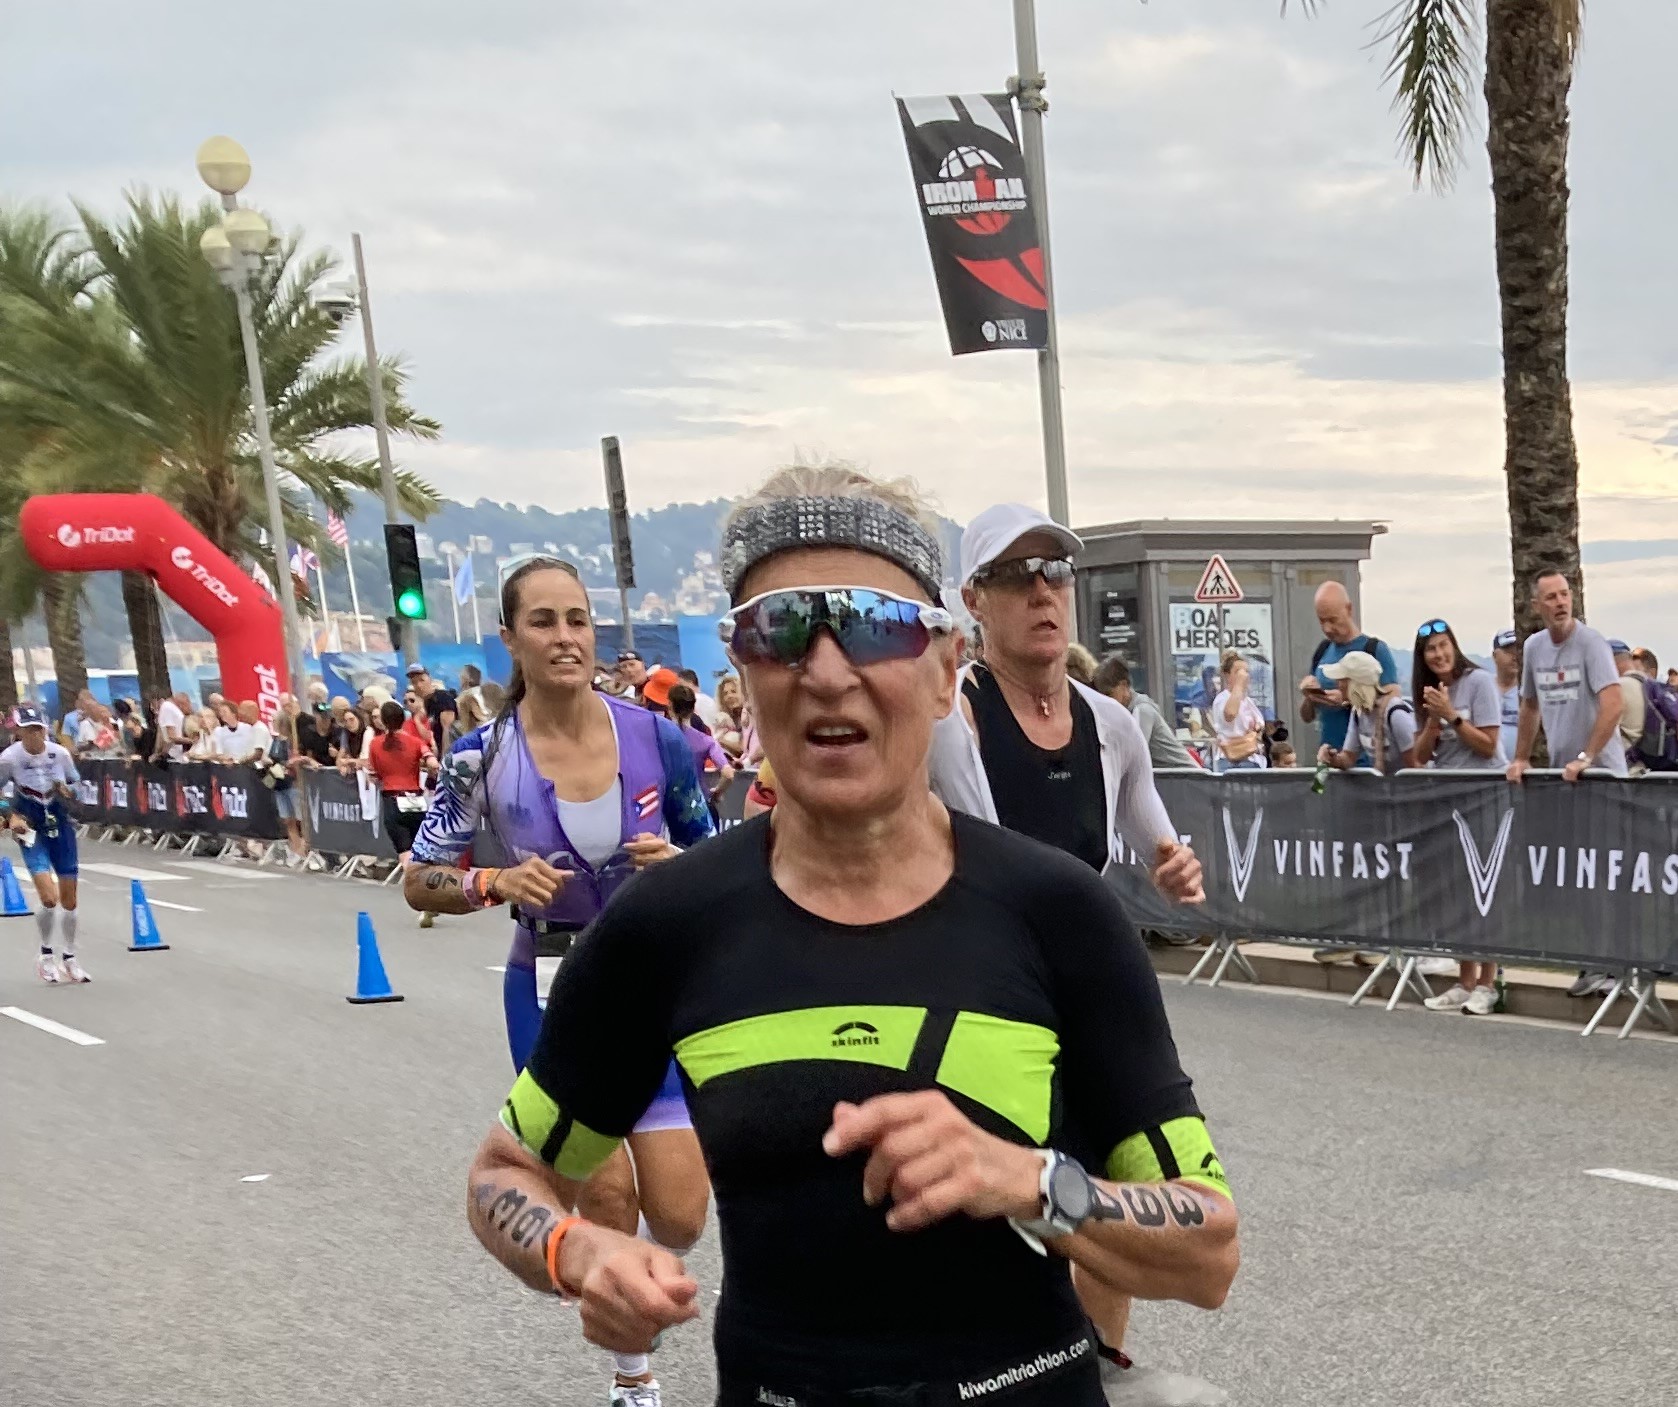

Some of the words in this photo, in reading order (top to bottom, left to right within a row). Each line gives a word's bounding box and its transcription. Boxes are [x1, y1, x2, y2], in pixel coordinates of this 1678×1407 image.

[83, 526, 136, 544] TriDot
[191, 563, 239, 608] TriDot
[1273, 839, 1413, 880] VINFAST
[832, 1036, 880, 1047] skinfit
